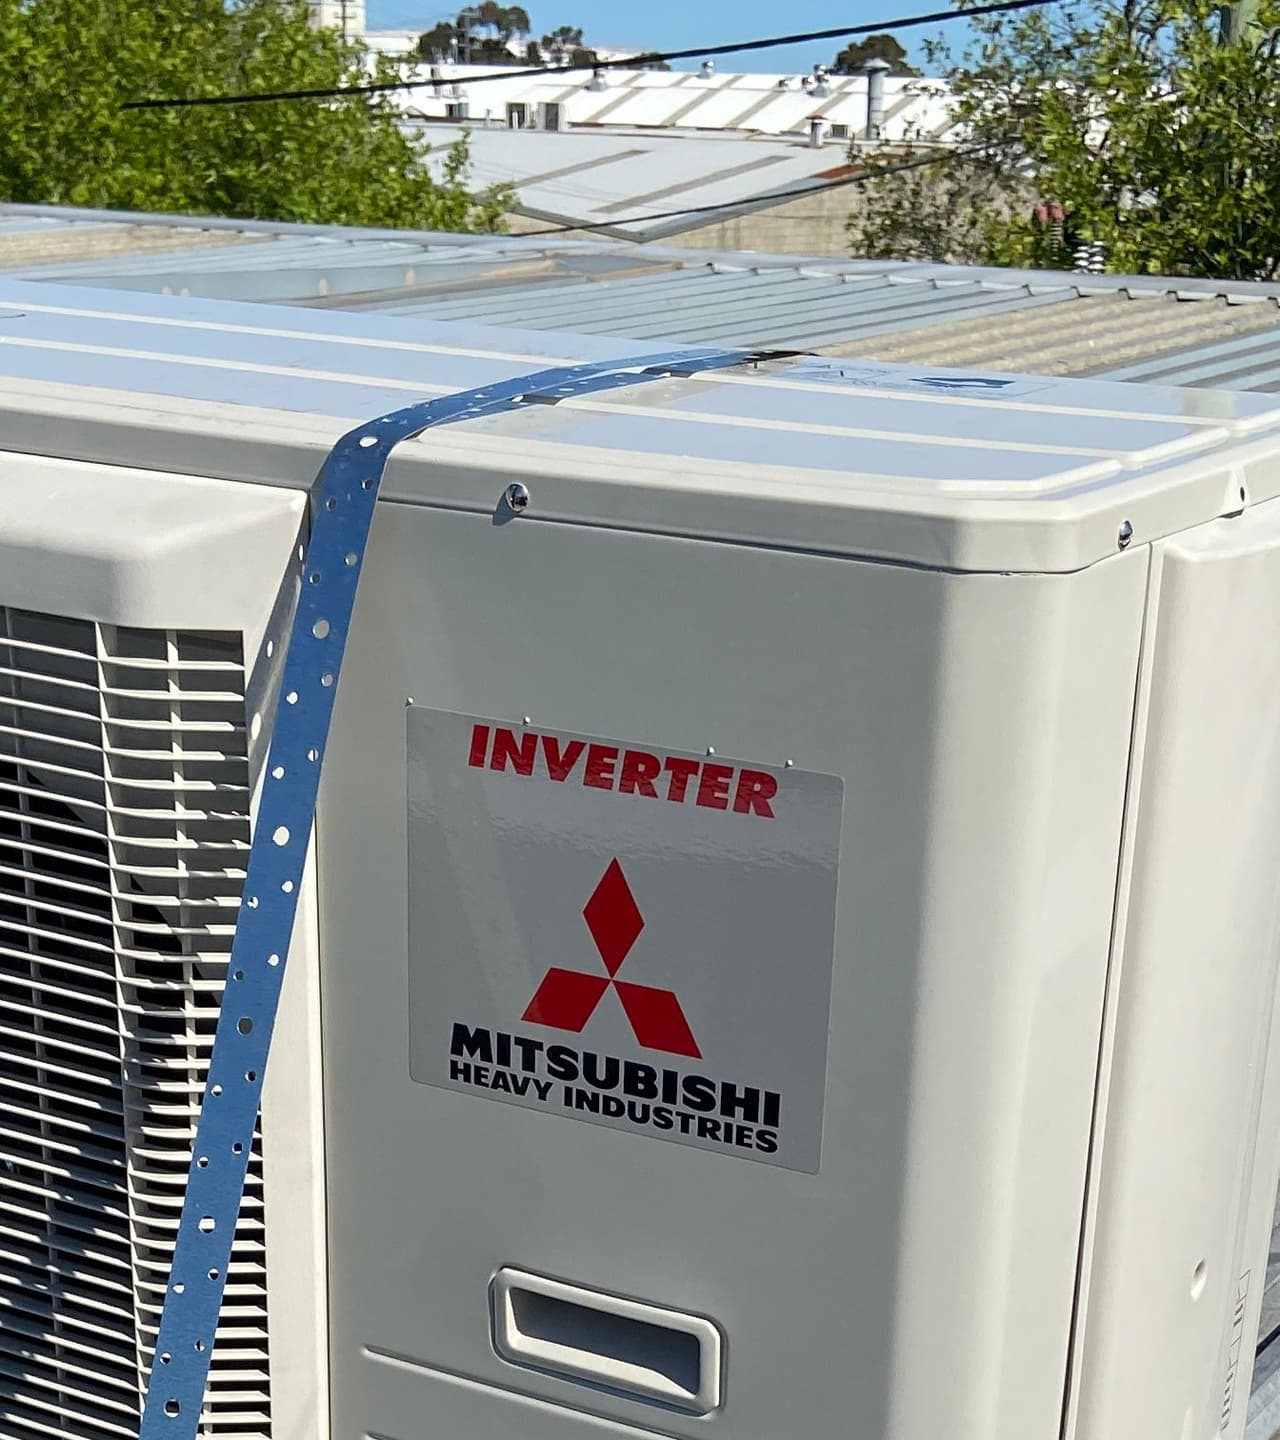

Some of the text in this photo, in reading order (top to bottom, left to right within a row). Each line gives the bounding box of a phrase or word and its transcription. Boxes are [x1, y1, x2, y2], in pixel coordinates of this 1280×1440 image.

[468, 724, 779, 819] INVERTER
[449, 1022, 781, 1129] MITSUBISHI
[449, 1060, 779, 1154] HEAVY INDUSTRIES
